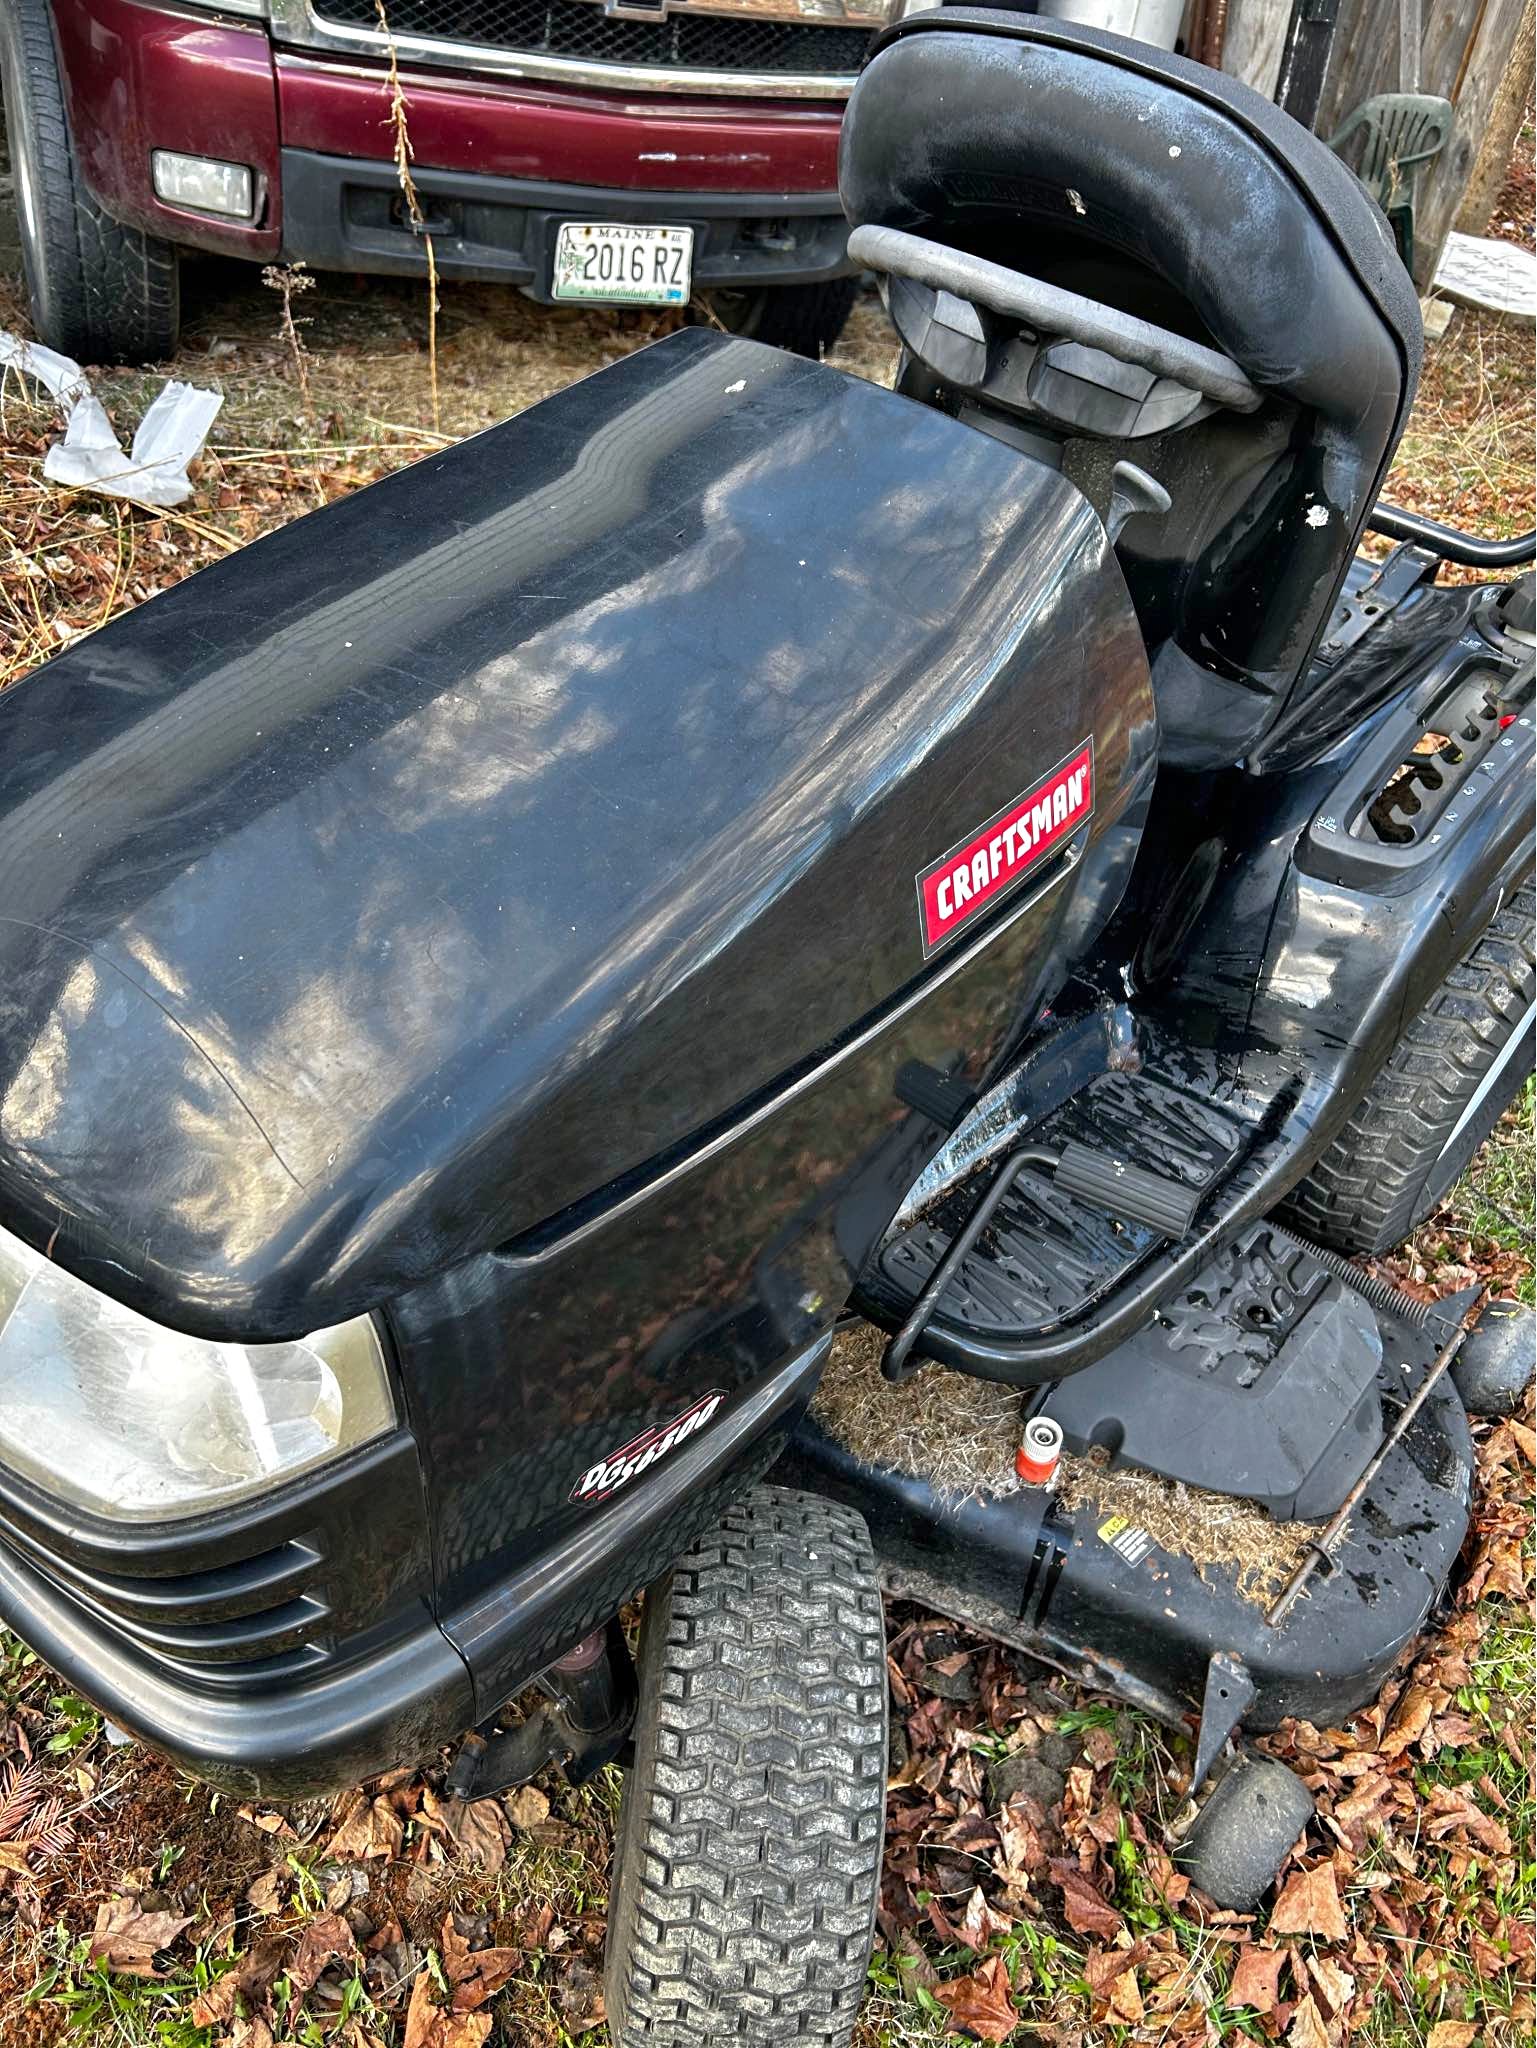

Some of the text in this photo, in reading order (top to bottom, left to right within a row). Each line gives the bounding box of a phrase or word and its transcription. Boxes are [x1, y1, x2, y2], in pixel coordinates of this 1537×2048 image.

[597, 229, 655, 240] MAINE
[583, 243, 684, 285] 2016 RZ
